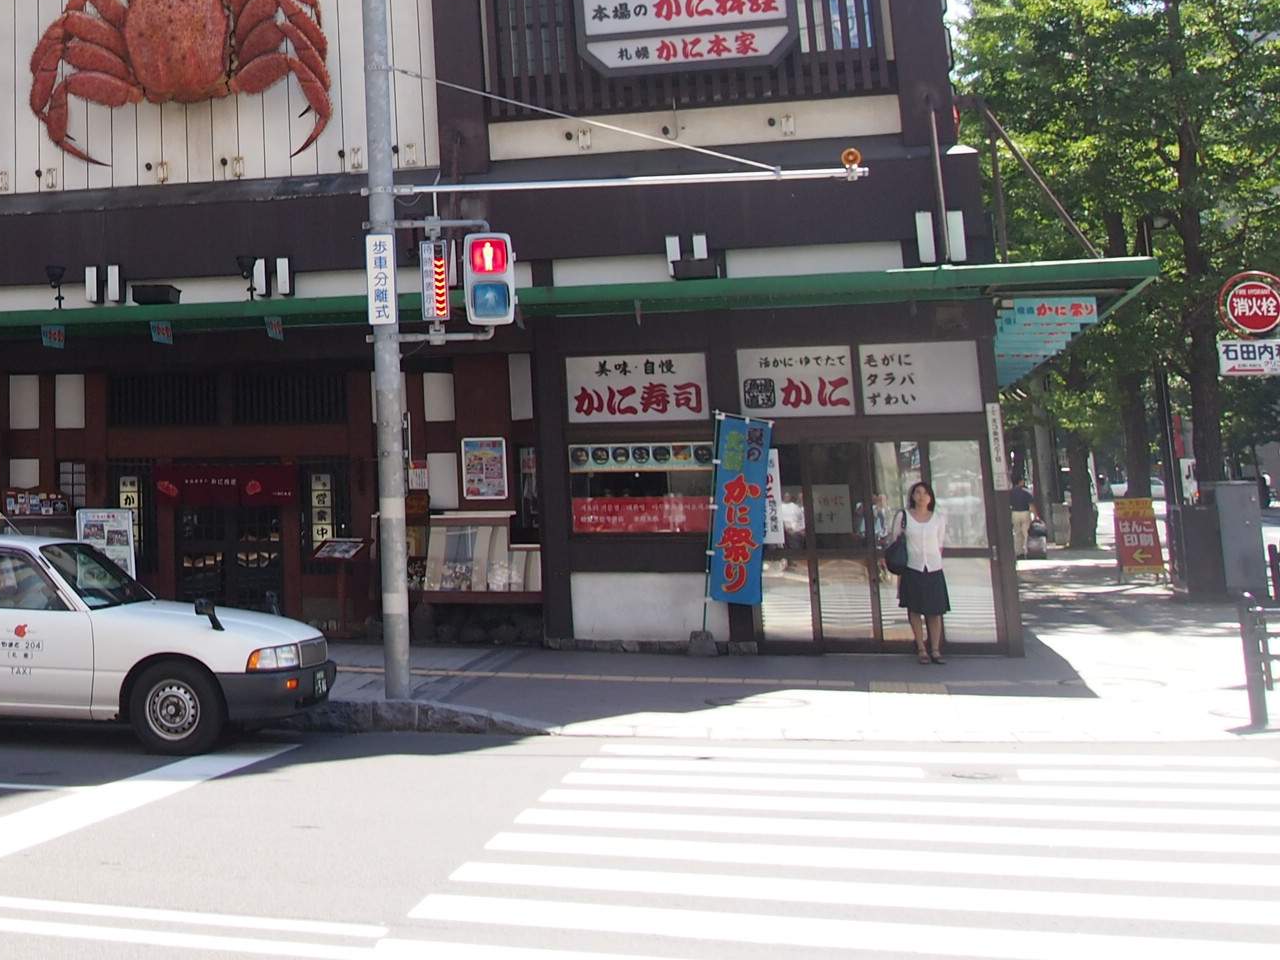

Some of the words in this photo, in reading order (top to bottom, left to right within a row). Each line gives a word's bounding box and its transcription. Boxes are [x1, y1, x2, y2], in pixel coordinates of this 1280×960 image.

[592, 2, 648, 22] 本場の
[618, 46, 650, 61] 札幌
[655, 31, 759, 62] かに本家
[372, 240, 390, 319] 歩車分離式
[1232, 297, 1278, 317] 消火栓
[595, 359, 676, 377] 美味・自慢
[864, 354, 912, 367] 毛がに
[867, 373, 915, 386] タラバ
[574, 382, 702, 416] かに寿司
[780, 377, 850, 408] かに
[867, 393, 917, 407] ずわい
[715, 473, 762, 594] かに祭り
[1120, 520, 1154, 533] はんこ
[25, 641, 41, 649] 204
[10, 666, 32, 675] TAXI
